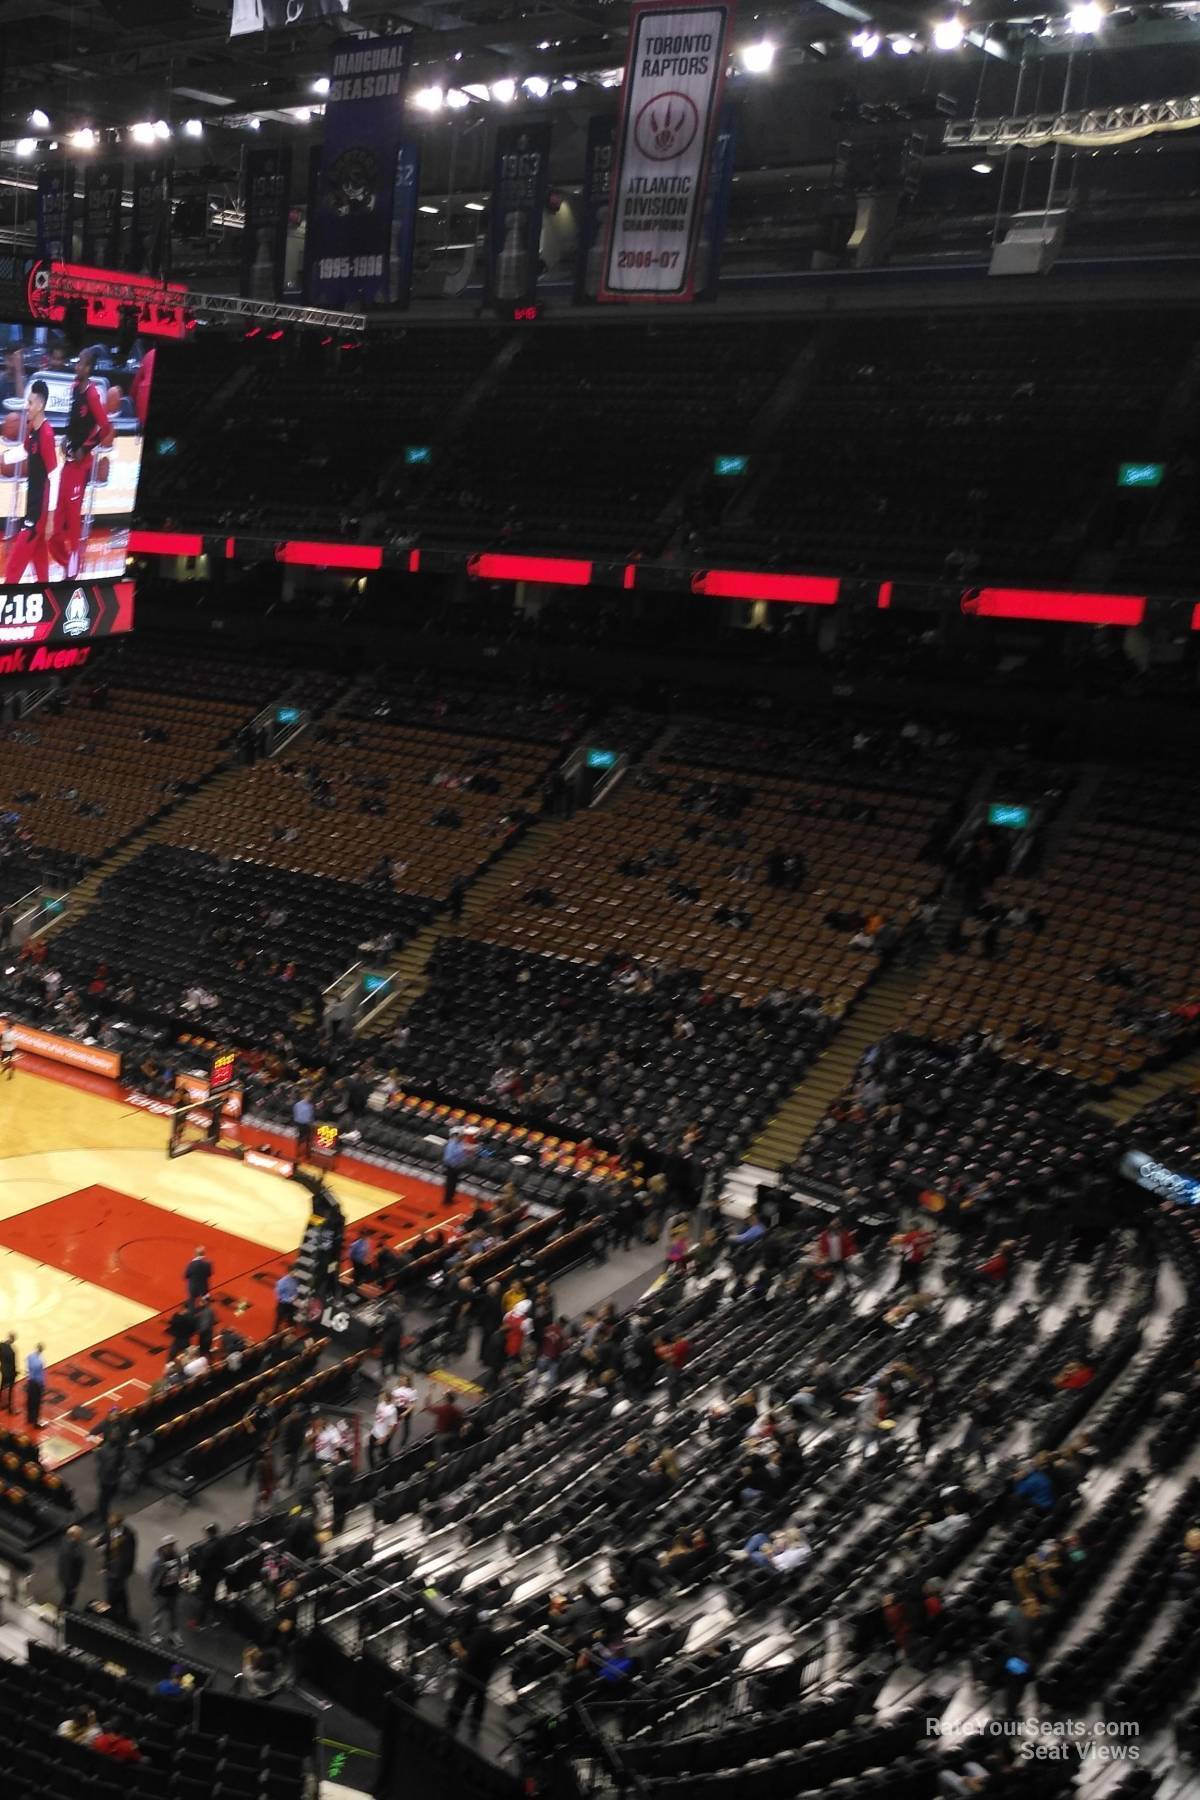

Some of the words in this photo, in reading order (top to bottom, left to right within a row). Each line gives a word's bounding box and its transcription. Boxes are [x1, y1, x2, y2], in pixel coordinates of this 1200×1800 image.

[645, 34, 713, 56] TORONTO
[333, 45, 403, 76] INAUGURAL
[641, 56, 709, 78] RAPTORS
[330, 73, 401, 102] SEASON
[626, 176, 691, 195] ATLANTIC
[623, 197, 689, 217] DIVISION
[622, 219, 685, 233] CHAMPIONS
[28, 645, 91, 673] Arena
